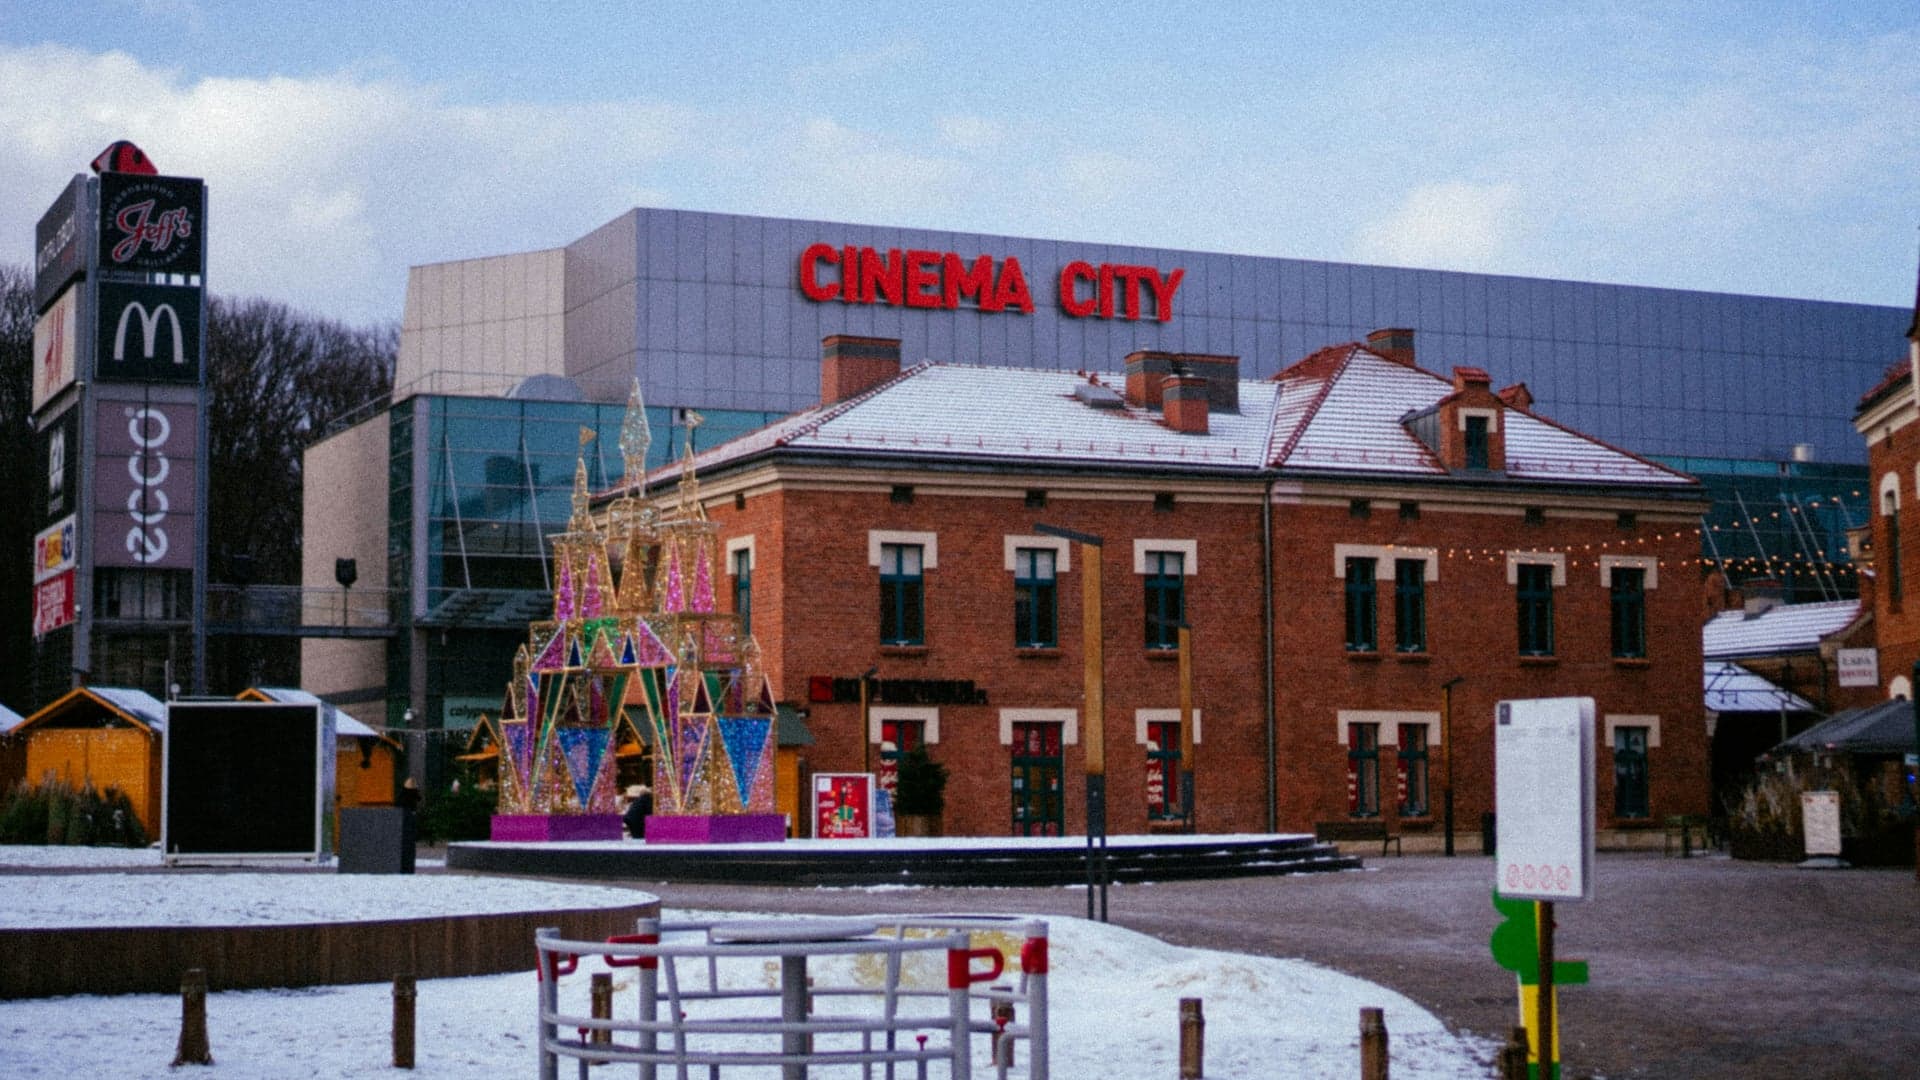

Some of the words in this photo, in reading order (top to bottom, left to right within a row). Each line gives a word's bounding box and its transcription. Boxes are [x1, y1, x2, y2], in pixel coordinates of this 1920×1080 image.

[112, 199, 192, 262] Jeff's
[800, 242, 1035, 315] CINEMA
[1060, 260, 1186, 324] CITY
[126, 408, 171, 564] ecco
